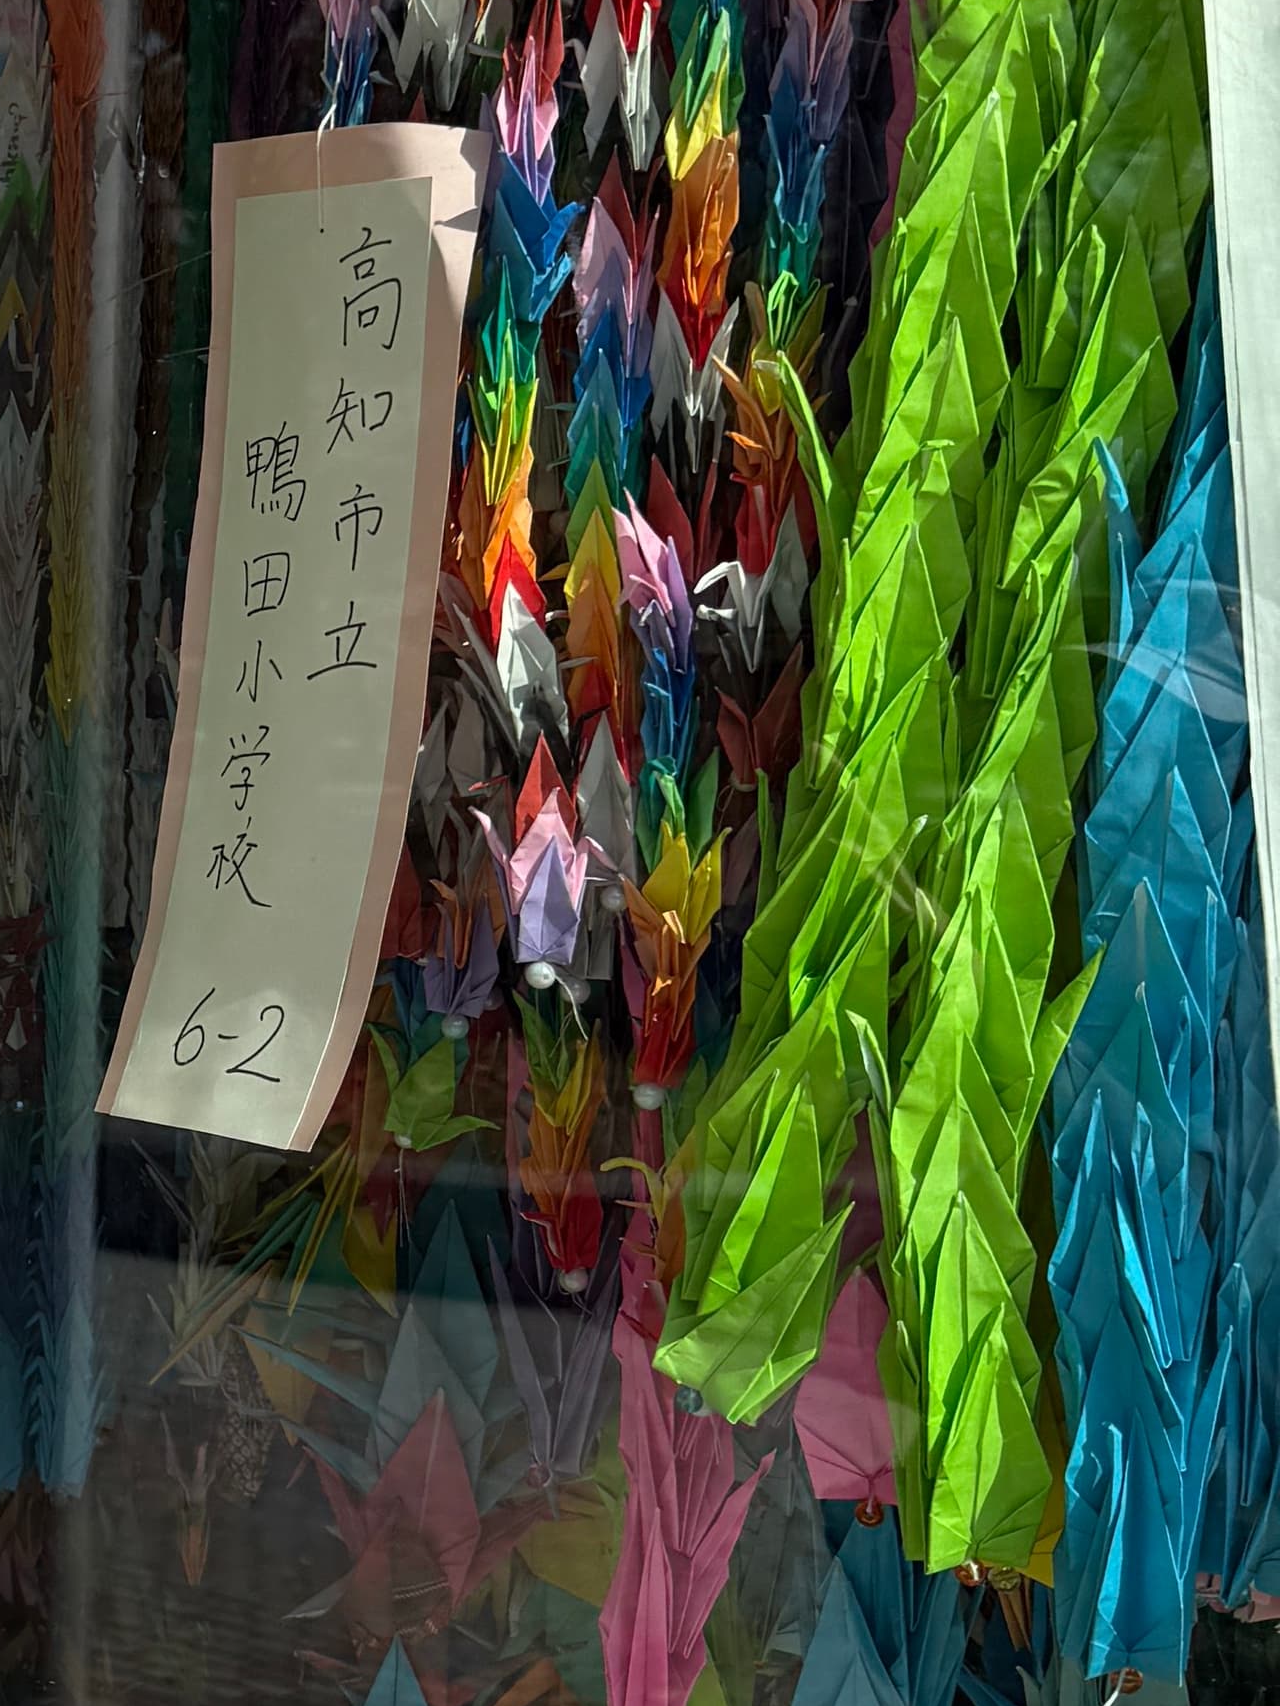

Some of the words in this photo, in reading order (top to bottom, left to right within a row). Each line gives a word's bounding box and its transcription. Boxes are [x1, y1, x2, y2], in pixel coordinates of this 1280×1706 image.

[205, 419, 307, 909] 鴨田小学校
[306, 225, 403, 683] 高知市立
[171, 986, 283, 1084] 6-2
